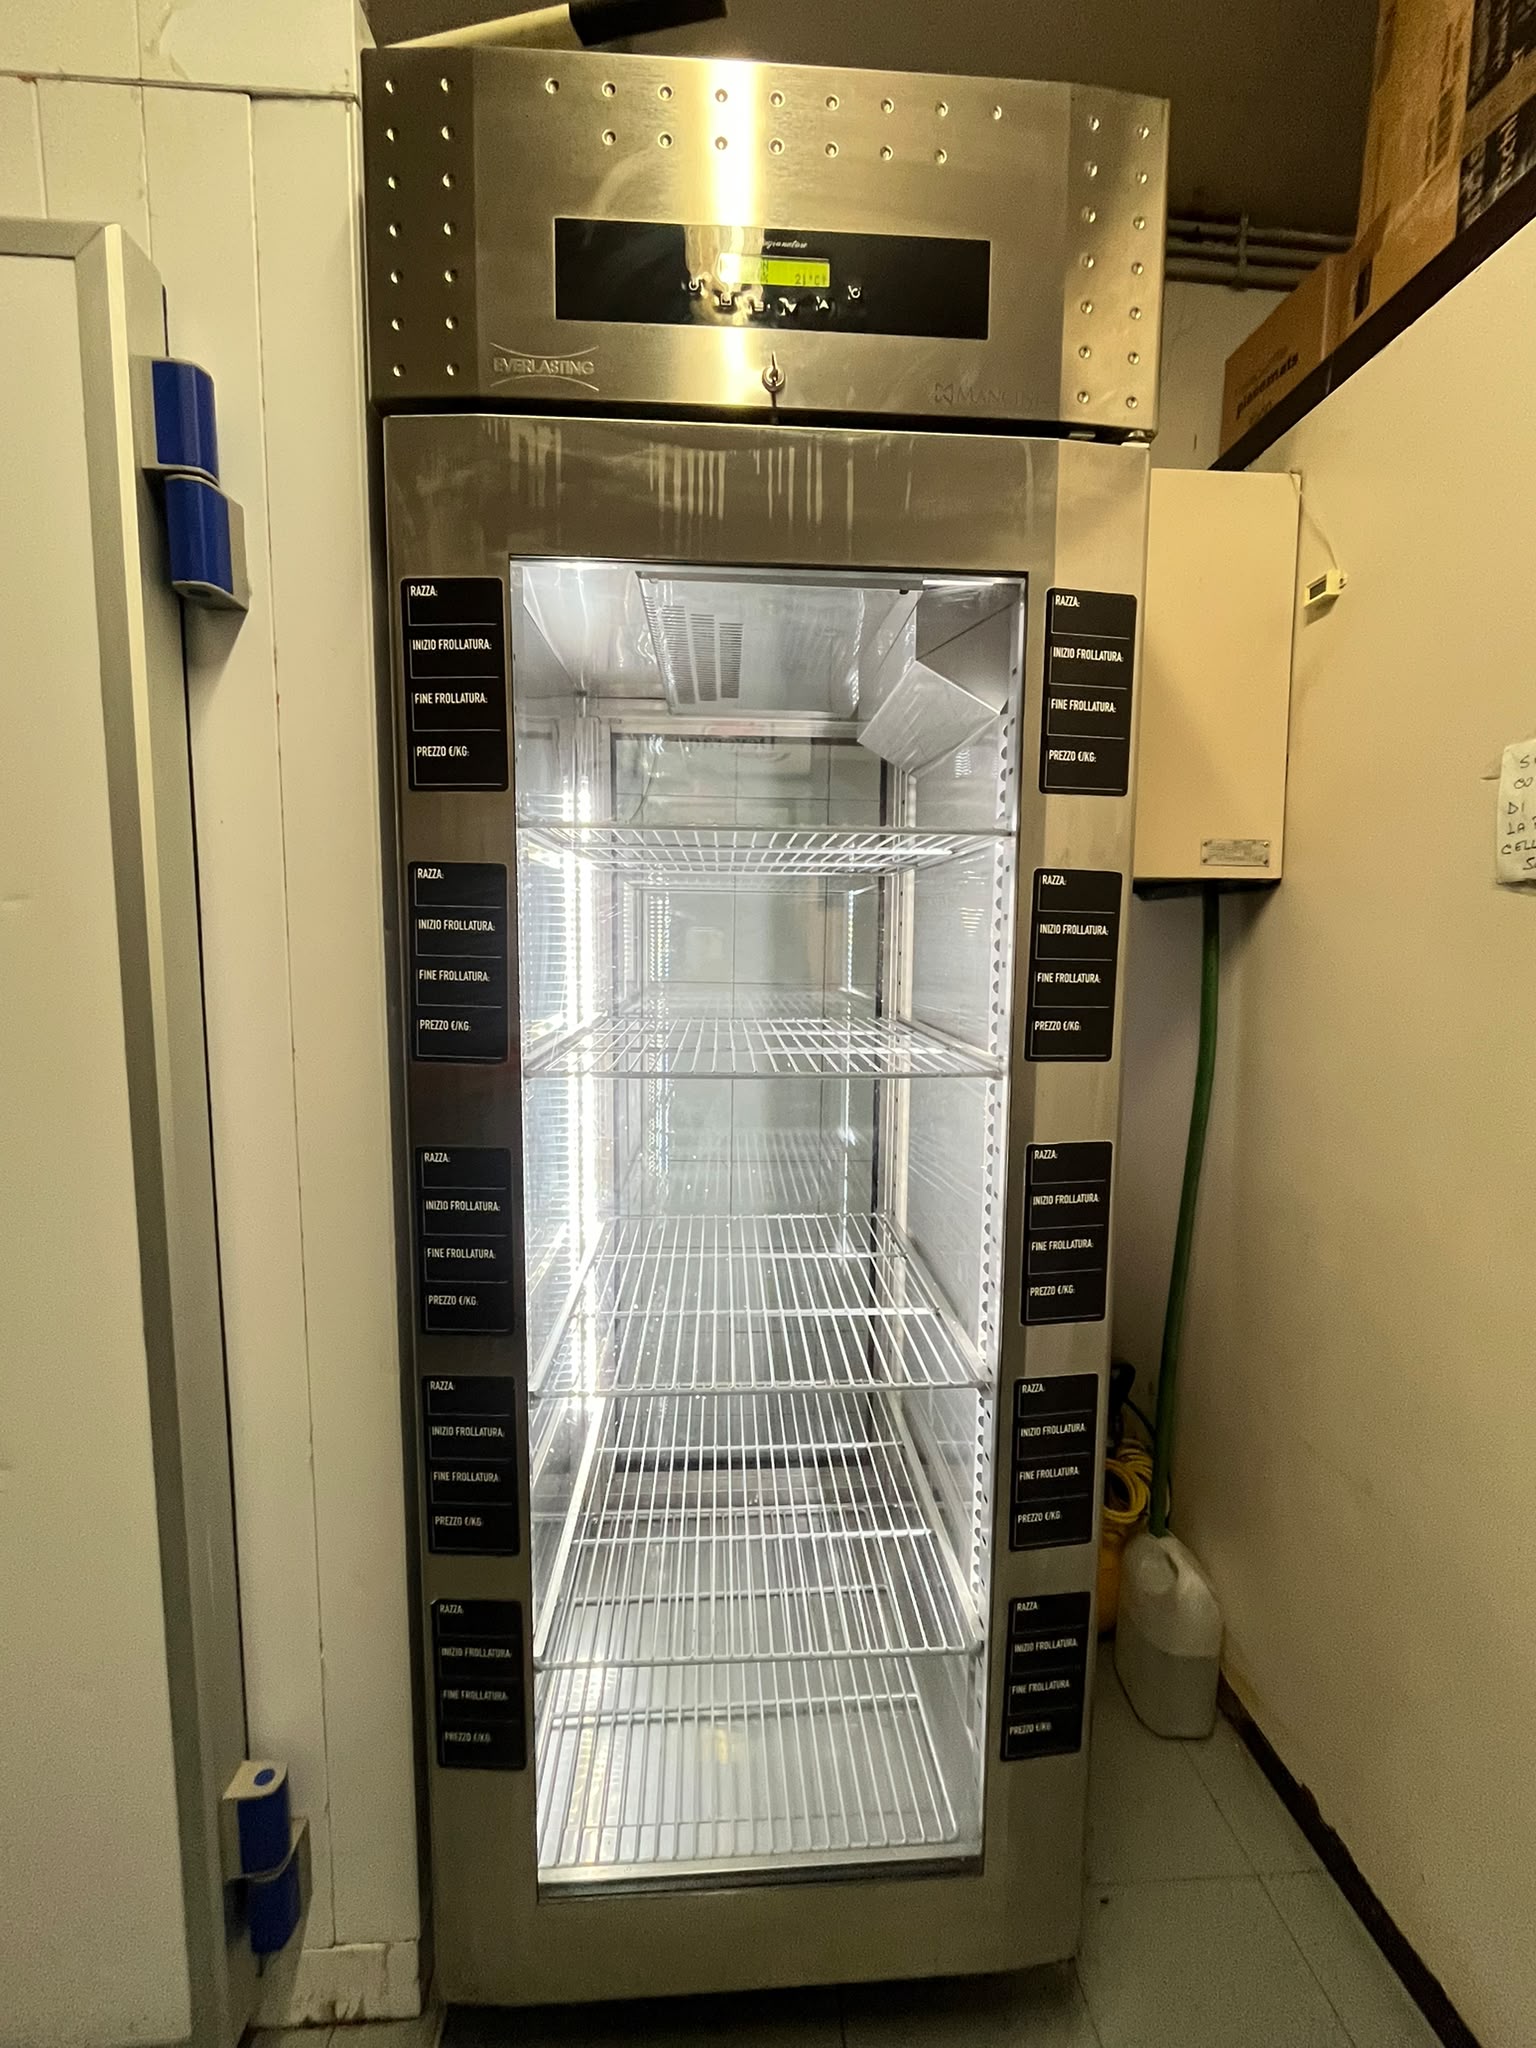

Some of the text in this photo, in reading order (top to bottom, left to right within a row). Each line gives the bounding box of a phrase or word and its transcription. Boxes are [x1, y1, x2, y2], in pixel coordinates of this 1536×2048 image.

[493, 357, 595, 376] EVERLASTING
[410, 585, 438, 596] RAZZA:
[1055, 595, 1080, 608] RAZZA:
[412, 638, 492, 650] INIZIO FROLLATURA:
[1053, 647, 1123, 663] INIZIO FROLLATURA:
[414, 693, 488, 704] FINE FROLLATURA:
[1051, 699, 1116, 713] FINE FROLLATURA:
[416, 746, 447, 757] PREZZO
[1049, 750, 1076, 762] PREZZO
[1507, 801, 1525, 815] DI
[1507, 822, 1526, 836] LA
[418, 919, 442, 930] INIZIO
[1040, 924, 1061, 934] INIZIO
[419, 970, 437, 981] FINE
[1037, 972, 1054, 983] FINE
[419, 1019, 449, 1031] PREZZO
[1034, 1020, 1061, 1031] PREZZO
[425, 1200, 449, 1211] INIZIO
[1032, 1195, 1054, 1206] INIZIO
[1031, 1241, 1047, 1252] FINE
[427, 1248, 445, 1258] FINE
[1030, 1286, 1056, 1296] PREZZO
[428, 1295, 457, 1305] PREZZO
[431, 1426, 454, 1436] INIZIO
[1021, 1426, 1041, 1437] INIZIO
[433, 1471, 450, 1481] FINE
[1019, 1470, 1035, 1480] FINE
[435, 1516, 462, 1526] PREZZO
[1018, 1512, 1043, 1524] PREZZO
